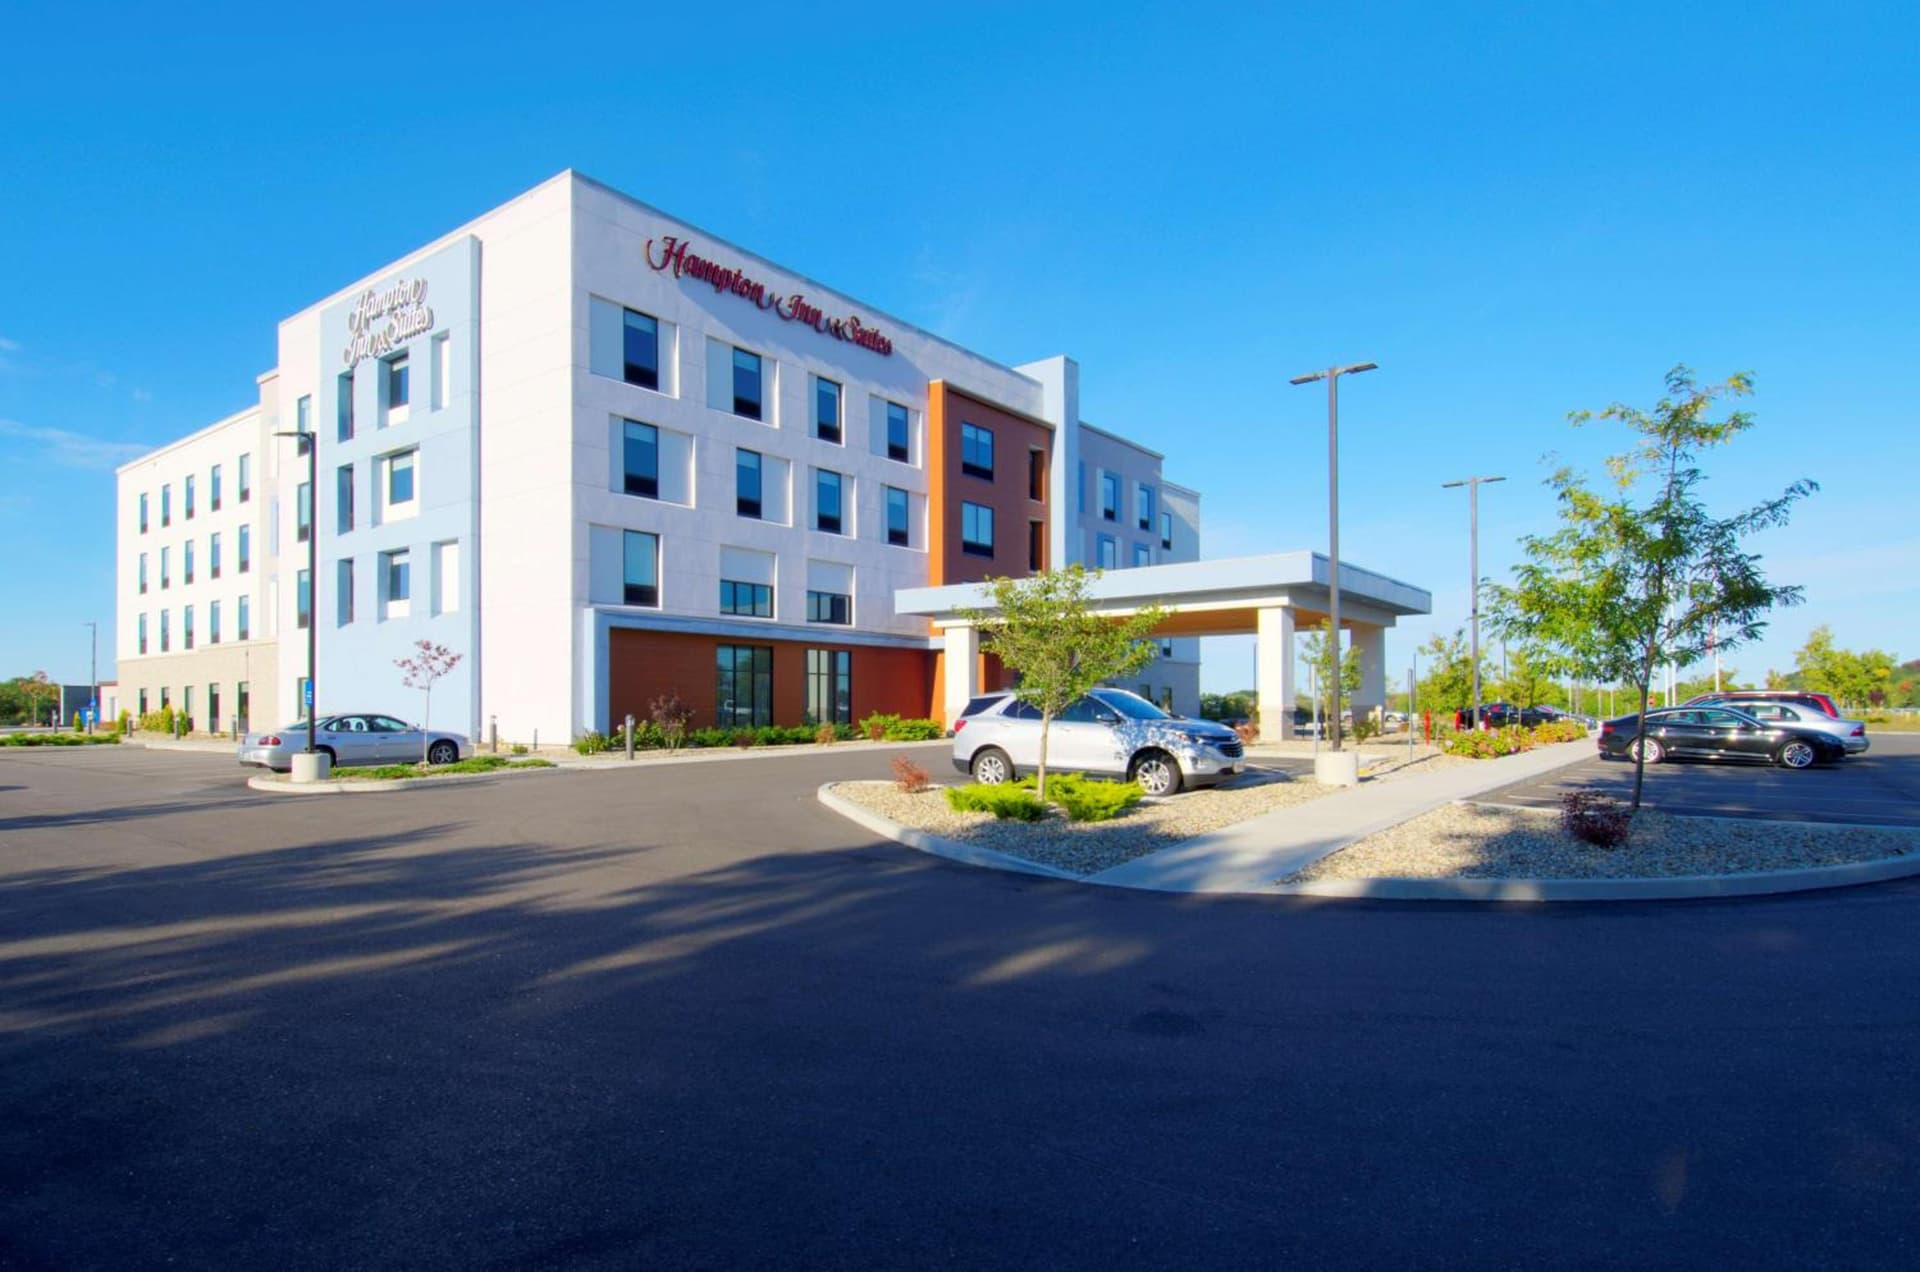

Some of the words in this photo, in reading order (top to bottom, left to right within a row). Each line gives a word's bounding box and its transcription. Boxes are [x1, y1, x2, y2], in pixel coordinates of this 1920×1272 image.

[348, 277, 428, 334] Hampton
[646, 235, 776, 310] Hampton
[776, 294, 831, 334] Inn
[842, 315, 893, 356] Suites
[387, 306, 434, 344] Suites
